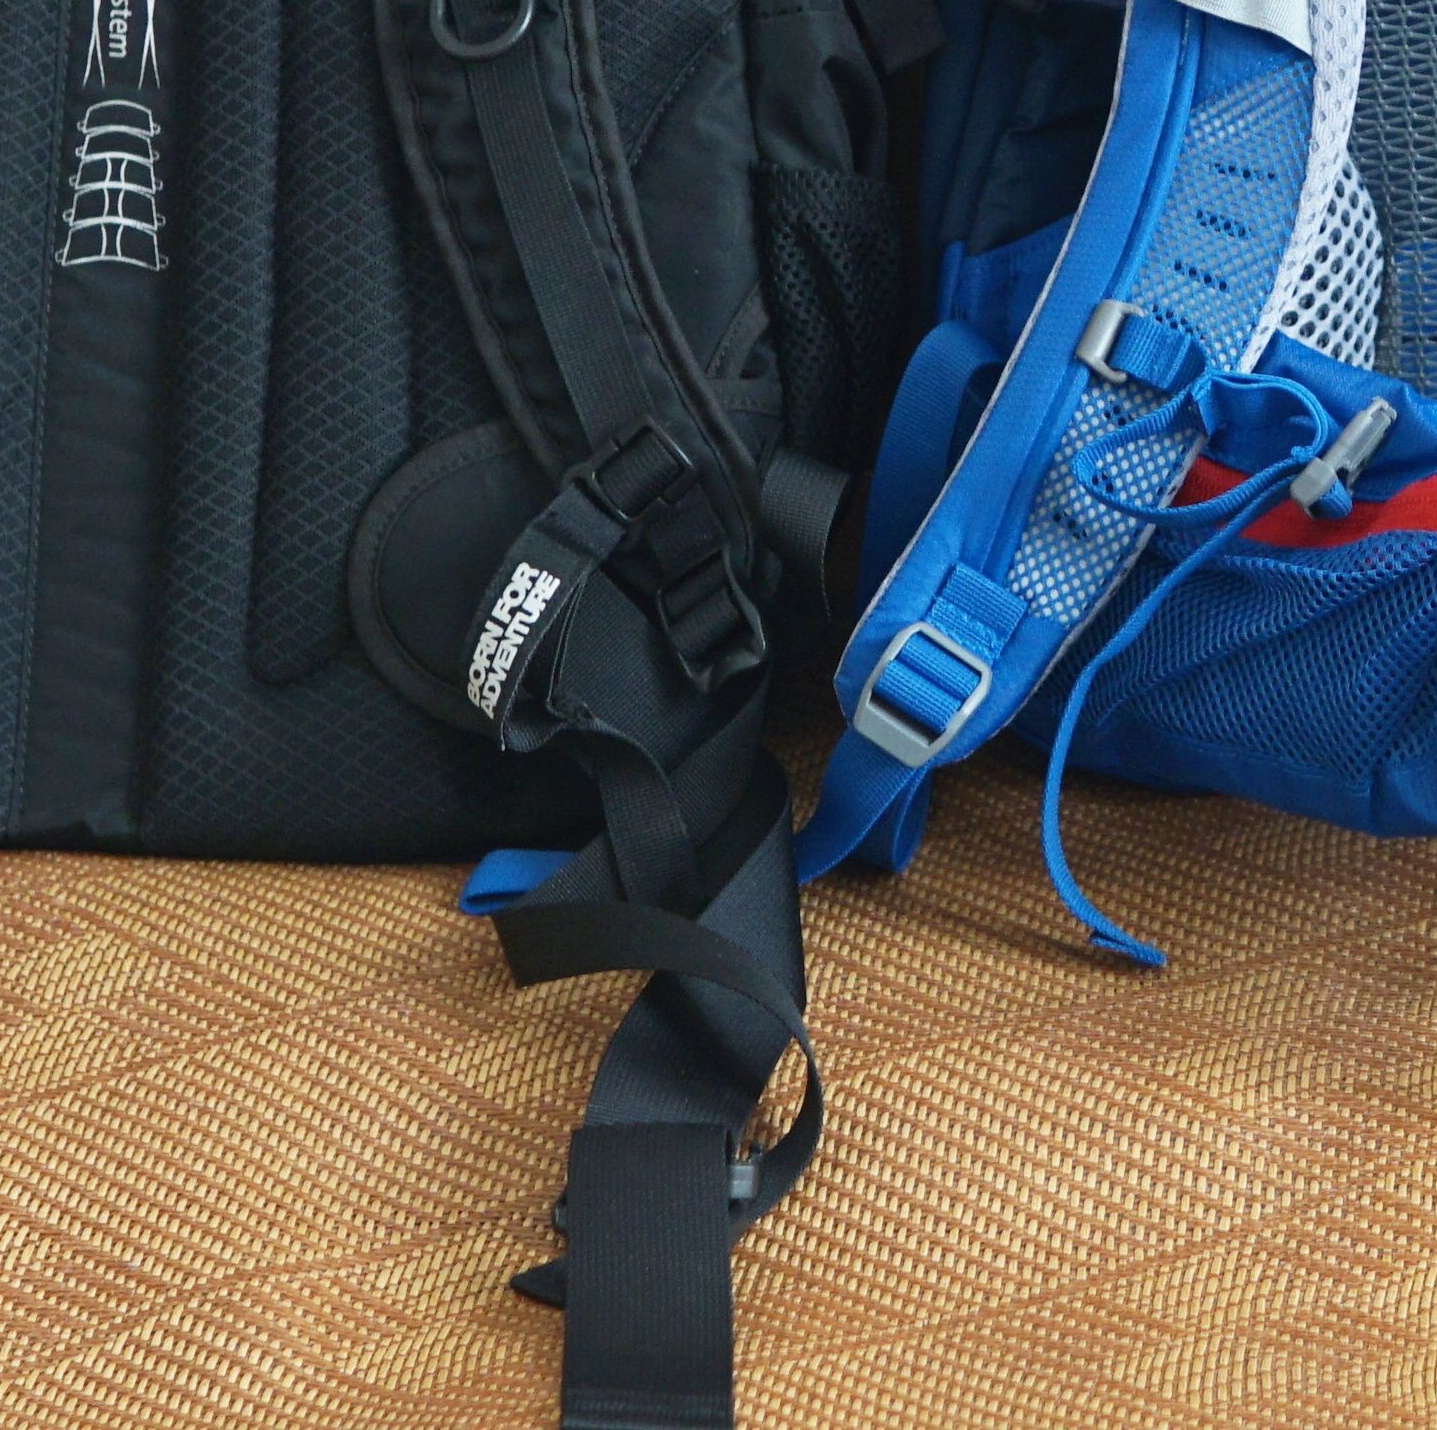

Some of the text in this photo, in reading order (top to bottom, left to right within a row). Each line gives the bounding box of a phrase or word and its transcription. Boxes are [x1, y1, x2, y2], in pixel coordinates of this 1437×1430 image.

[467, 561, 540, 708] BORN FOR
[480, 570, 561, 720] ADVENTURE
